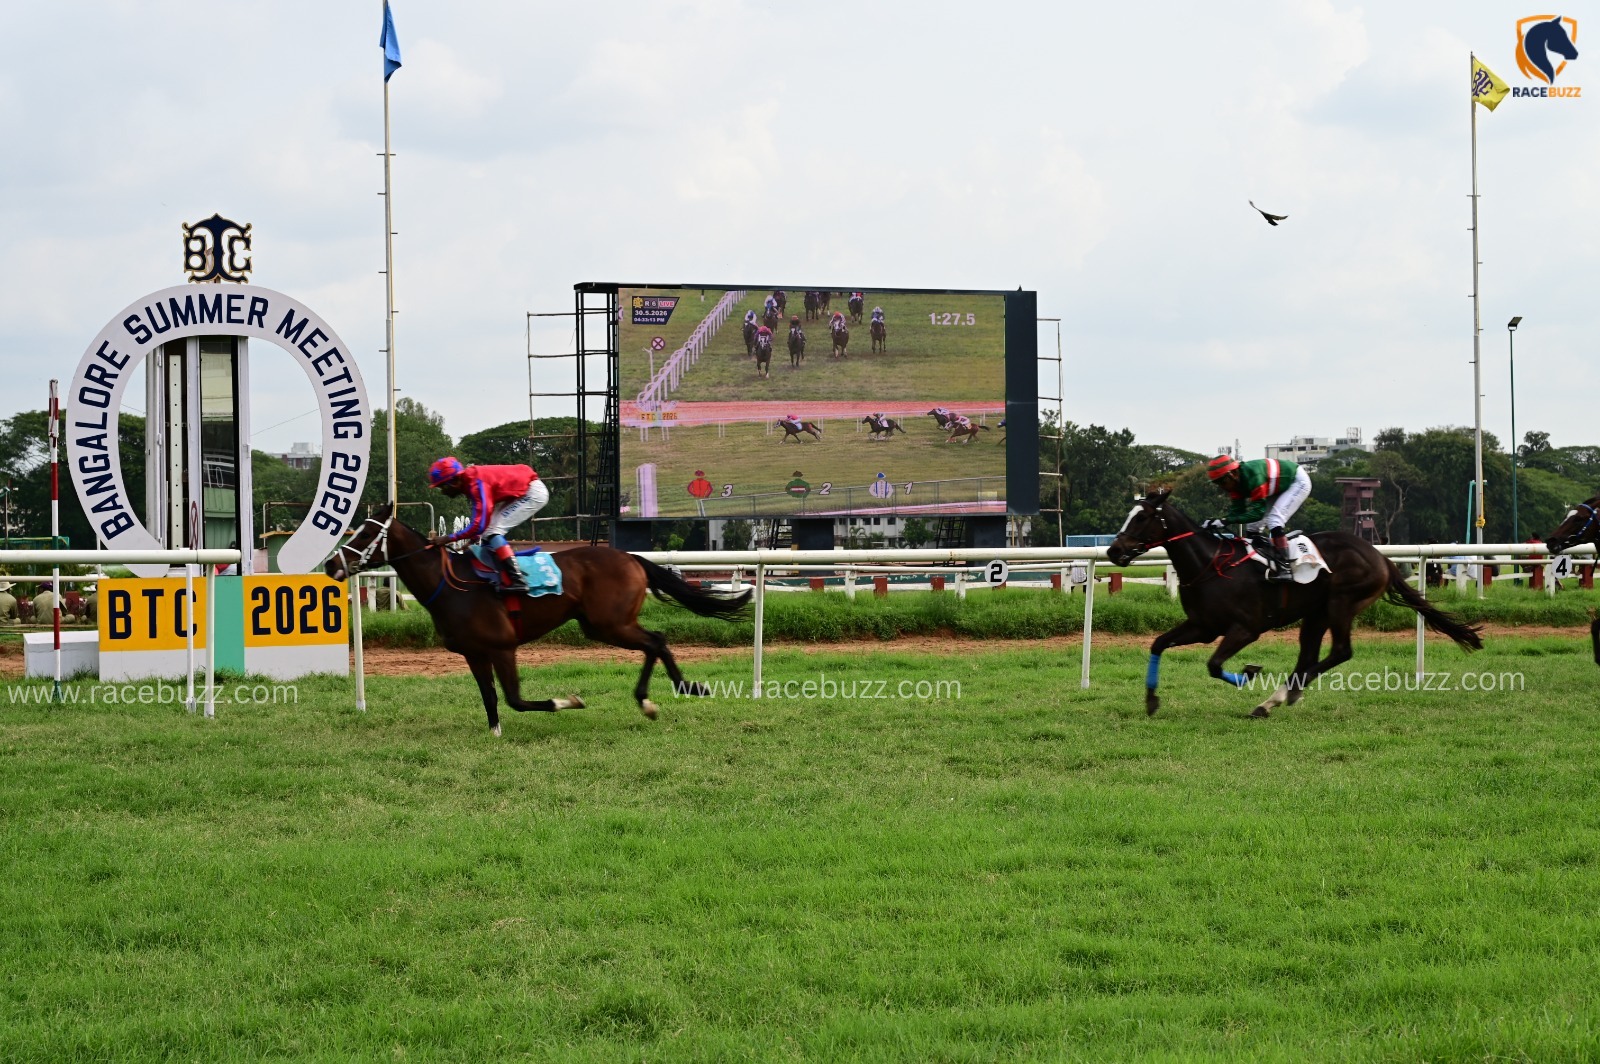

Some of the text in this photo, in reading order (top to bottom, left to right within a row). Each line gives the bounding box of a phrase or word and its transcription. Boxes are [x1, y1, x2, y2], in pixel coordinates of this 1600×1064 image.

[928, 312, 975, 325] 1:27.5
[75, 293, 363, 541] BANGALORE SUMMER MEETING 2026
[721, 484, 734, 498] 3
[819, 482, 833, 495] 2
[904, 481, 914, 495] 1
[990, 563, 1003, 583] 2
[1555, 557, 1568, 576] 4
[108, 585, 342, 640] BTC 2026
